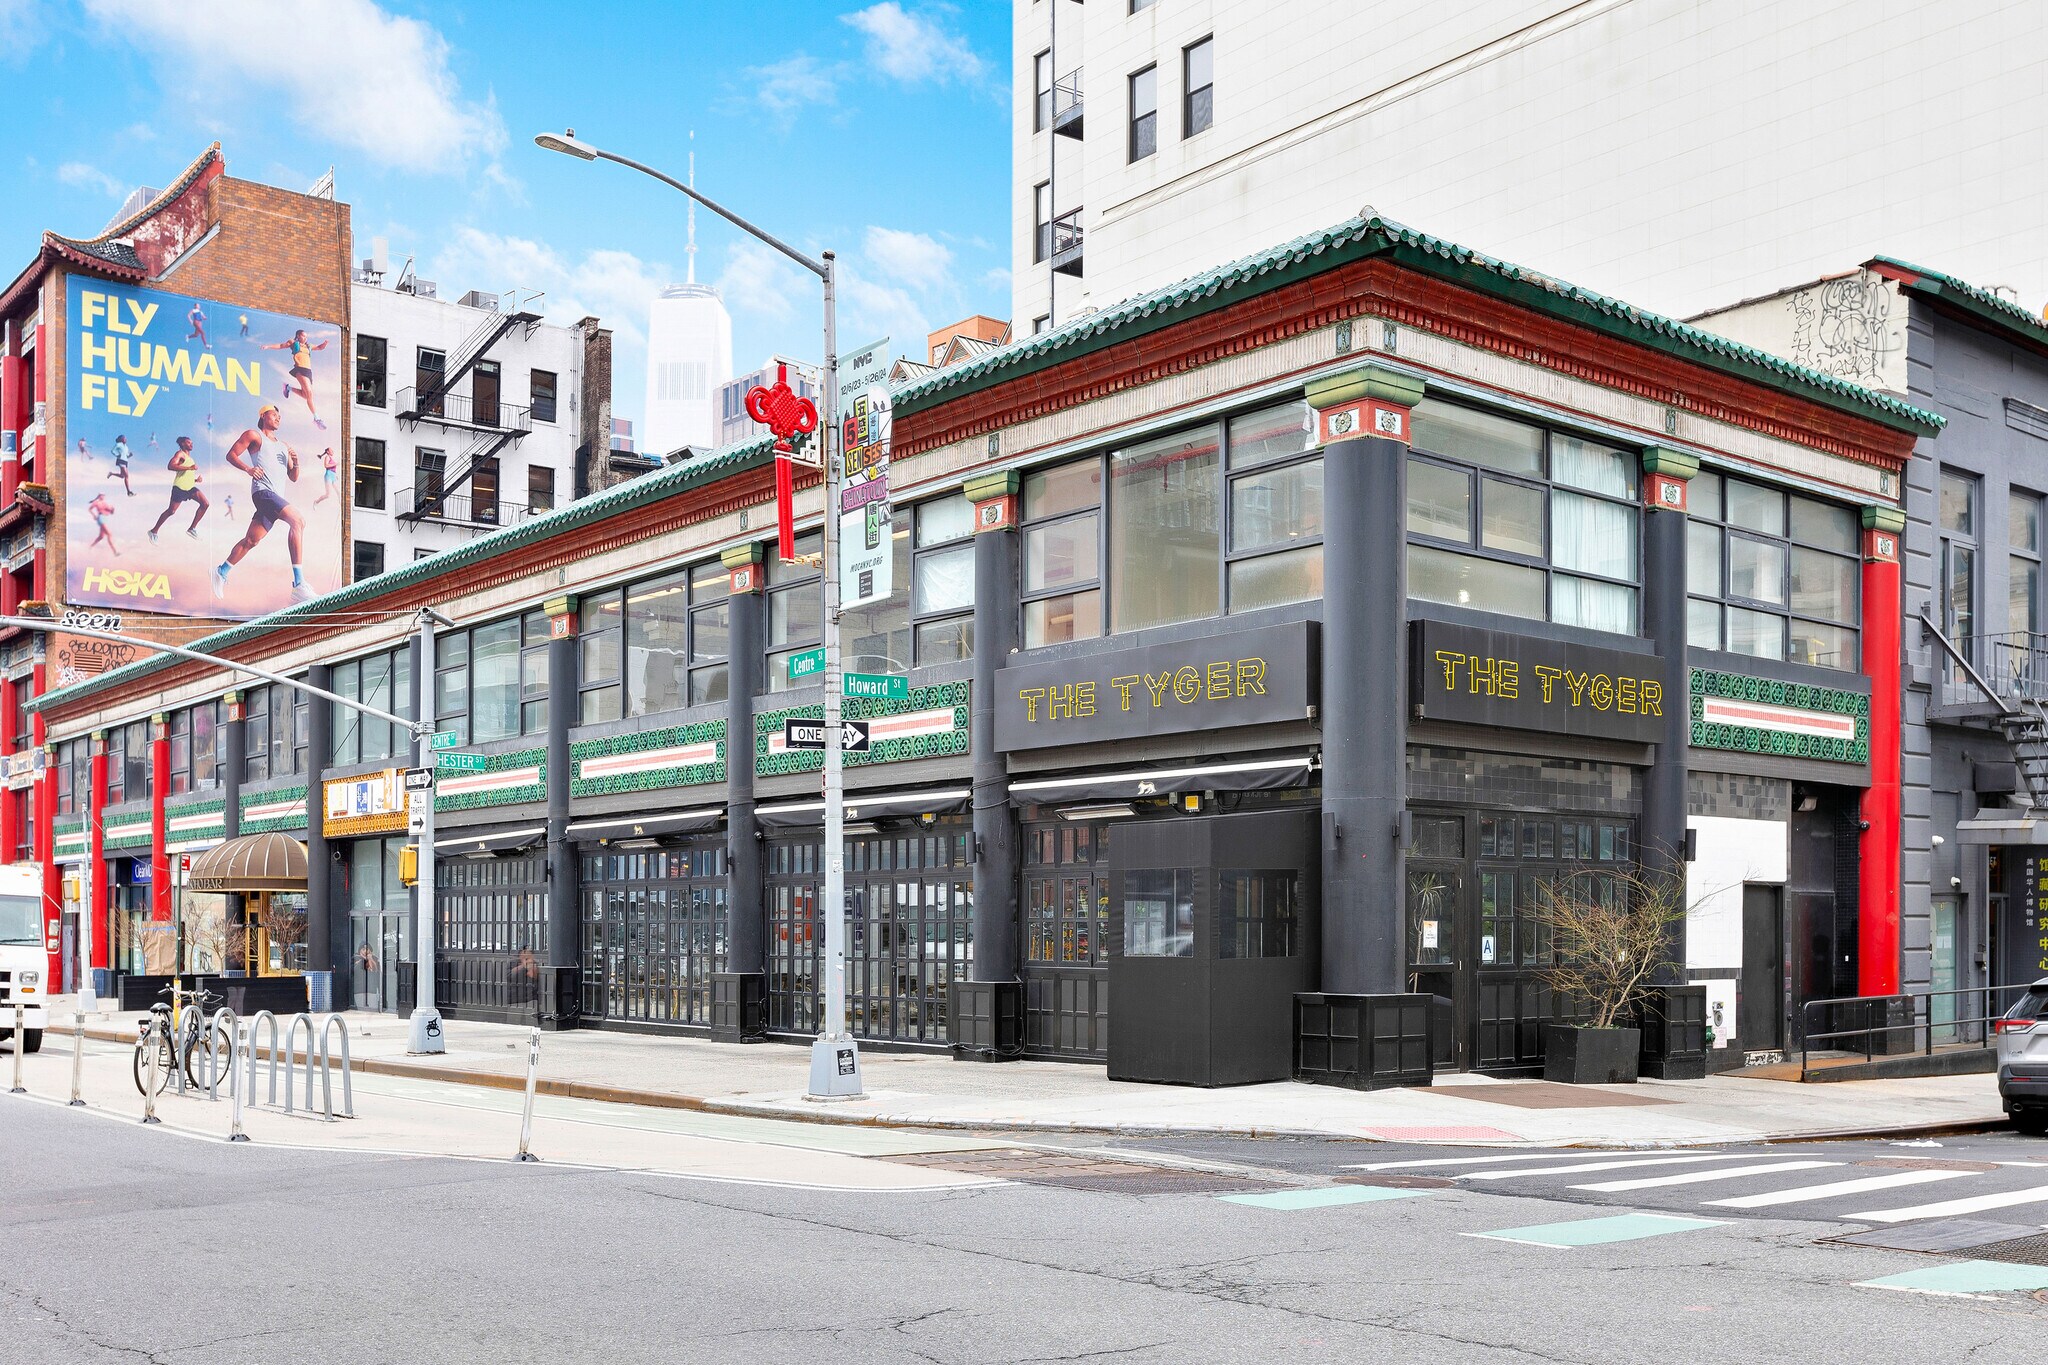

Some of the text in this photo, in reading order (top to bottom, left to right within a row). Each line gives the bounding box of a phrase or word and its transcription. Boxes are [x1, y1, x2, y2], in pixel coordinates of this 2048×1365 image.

[82, 290, 159, 336] FLY
[82, 332, 260, 397] HUMAN
[853, 352, 872, 370] NYC
[82, 374, 160, 417] FLY
[847, 422, 855, 445] 5
[844, 480, 886, 508] CHINATOWN
[868, 503, 877, 542] 唐人街
[82, 567, 172, 599] HOKA
[793, 650, 823, 675] Centre St
[849, 676, 901, 695] Howard St
[1019, 657, 1267, 722] THE TYGER
[1436, 650, 1663, 716] THE TYGER
[432, 733, 451, 748] CENTRE
[798, 728, 857, 741] ONE AY
[438, 754, 474, 768] HESTER
[414, 793, 422, 803] ALL
[2026, 858, 2034, 926] 美国华人博物馆
[1484, 940, 1491, 953] A
